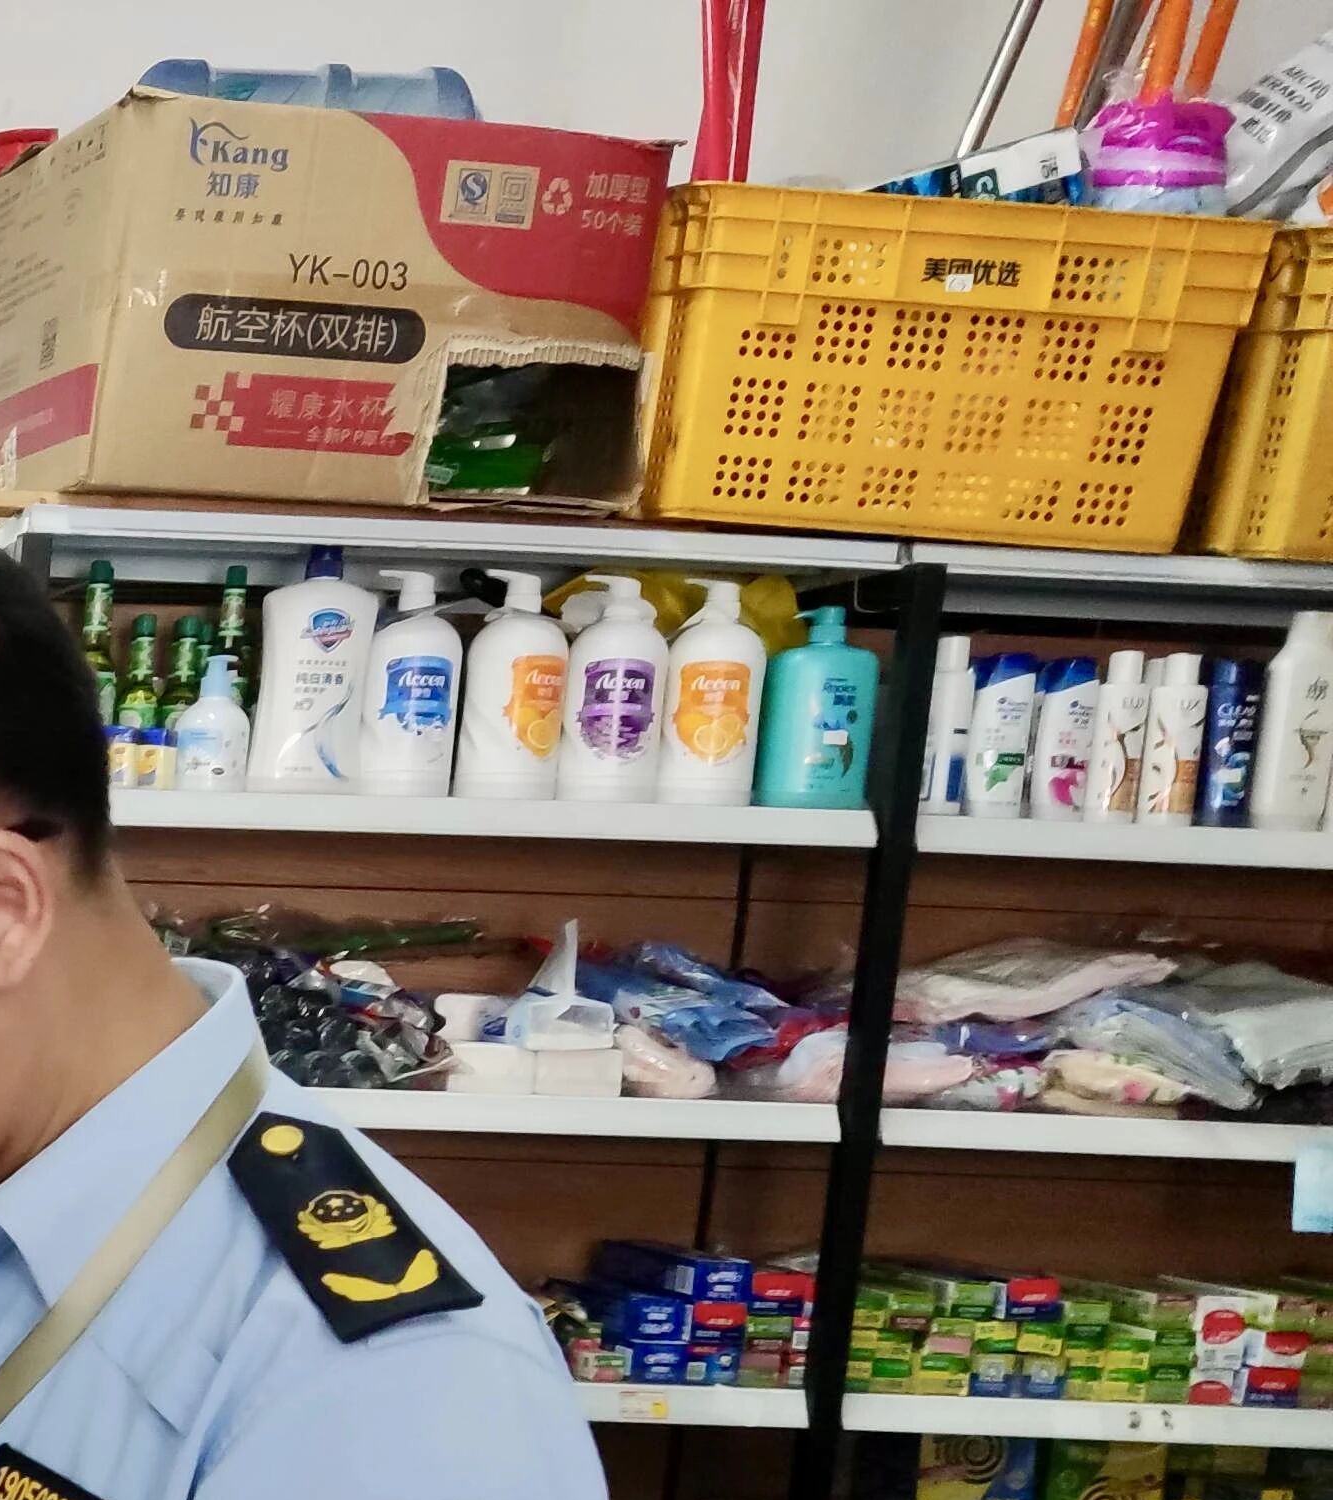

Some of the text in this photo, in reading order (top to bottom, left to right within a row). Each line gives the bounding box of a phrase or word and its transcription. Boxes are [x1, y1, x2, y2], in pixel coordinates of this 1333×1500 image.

[585, 170, 651, 204] 加厚型
[581, 208, 645, 237] 50个装
[288, 253, 409, 292] YK-003
[921, 256, 1021, 288] 美团优选
[195, 302, 400, 357] 航空杯(双排)
